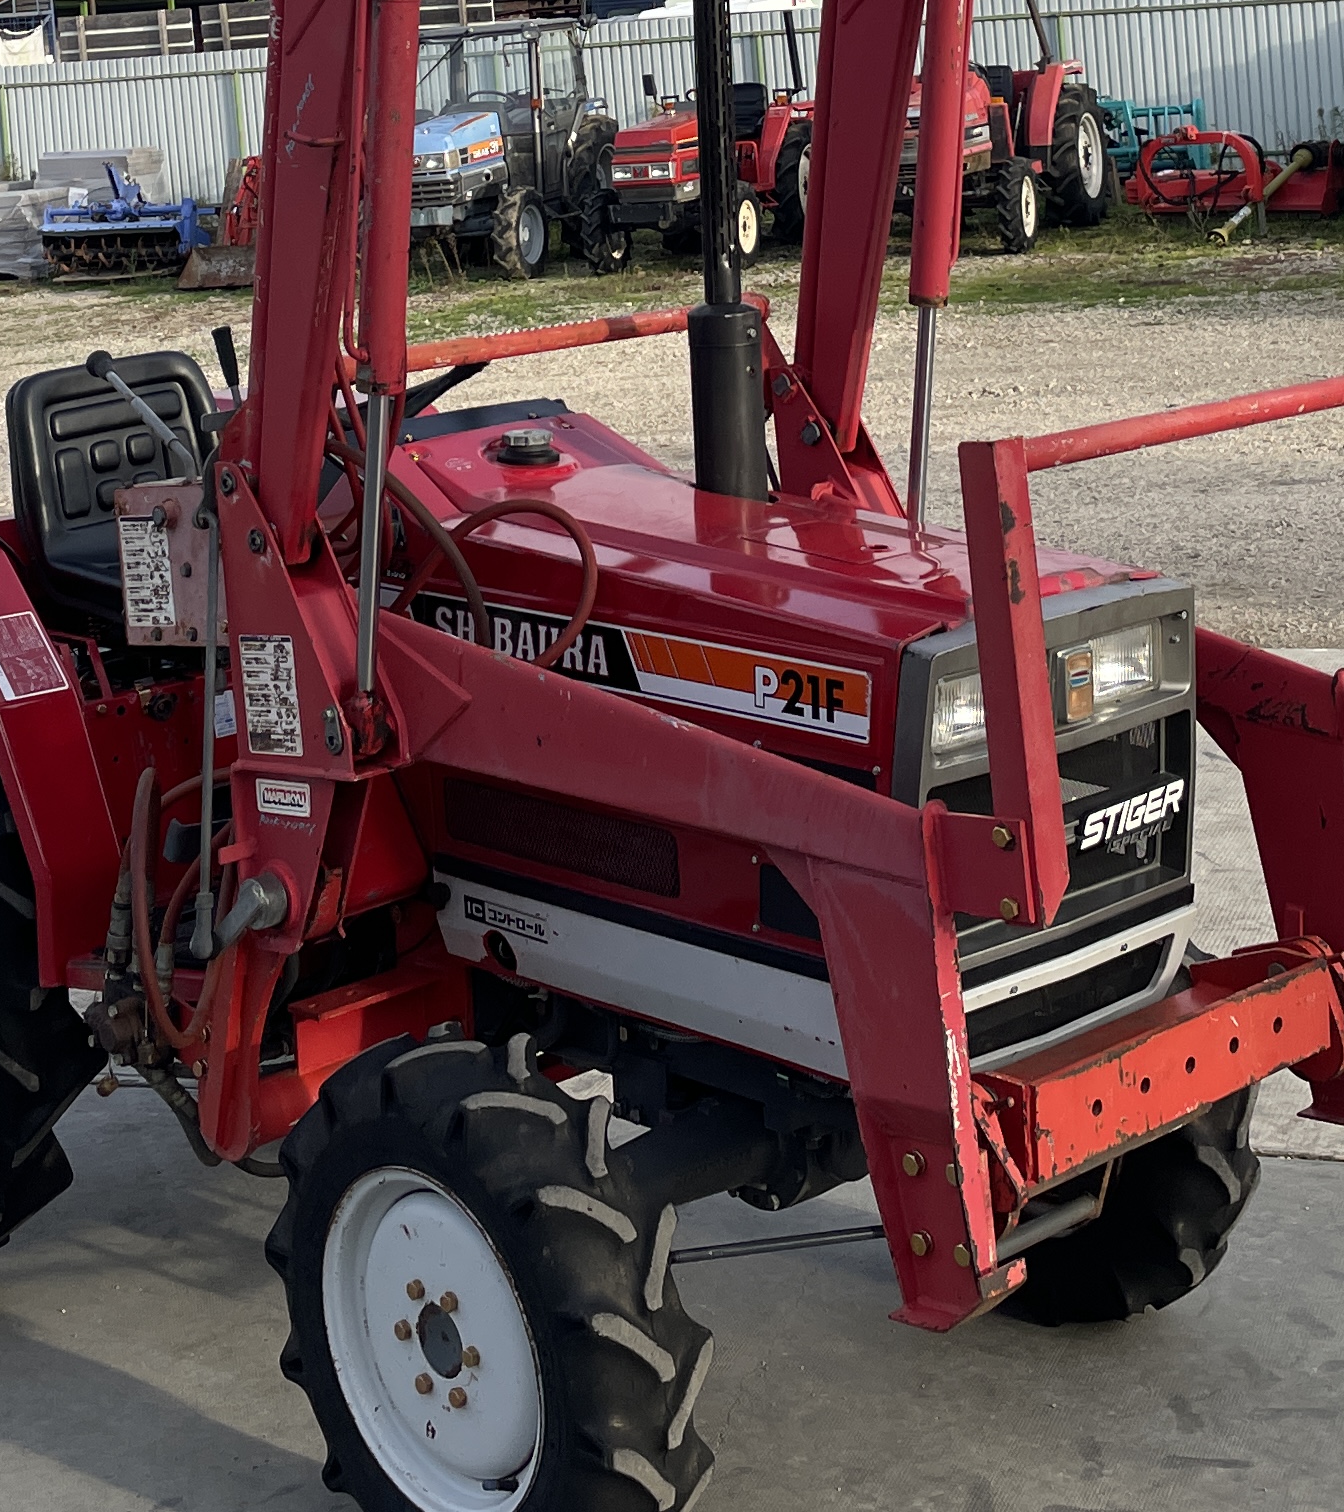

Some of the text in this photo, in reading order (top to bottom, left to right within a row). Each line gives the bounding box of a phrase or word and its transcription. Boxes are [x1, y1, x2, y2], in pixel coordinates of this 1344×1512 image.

[435, 606, 609, 676] SHBAURA
[754, 665, 844, 723] P21F
[263, 787, 306, 808] MARUKYU
[1080, 778, 1185, 851] STIGER
[467, 900, 545, 936] IC コントロール
